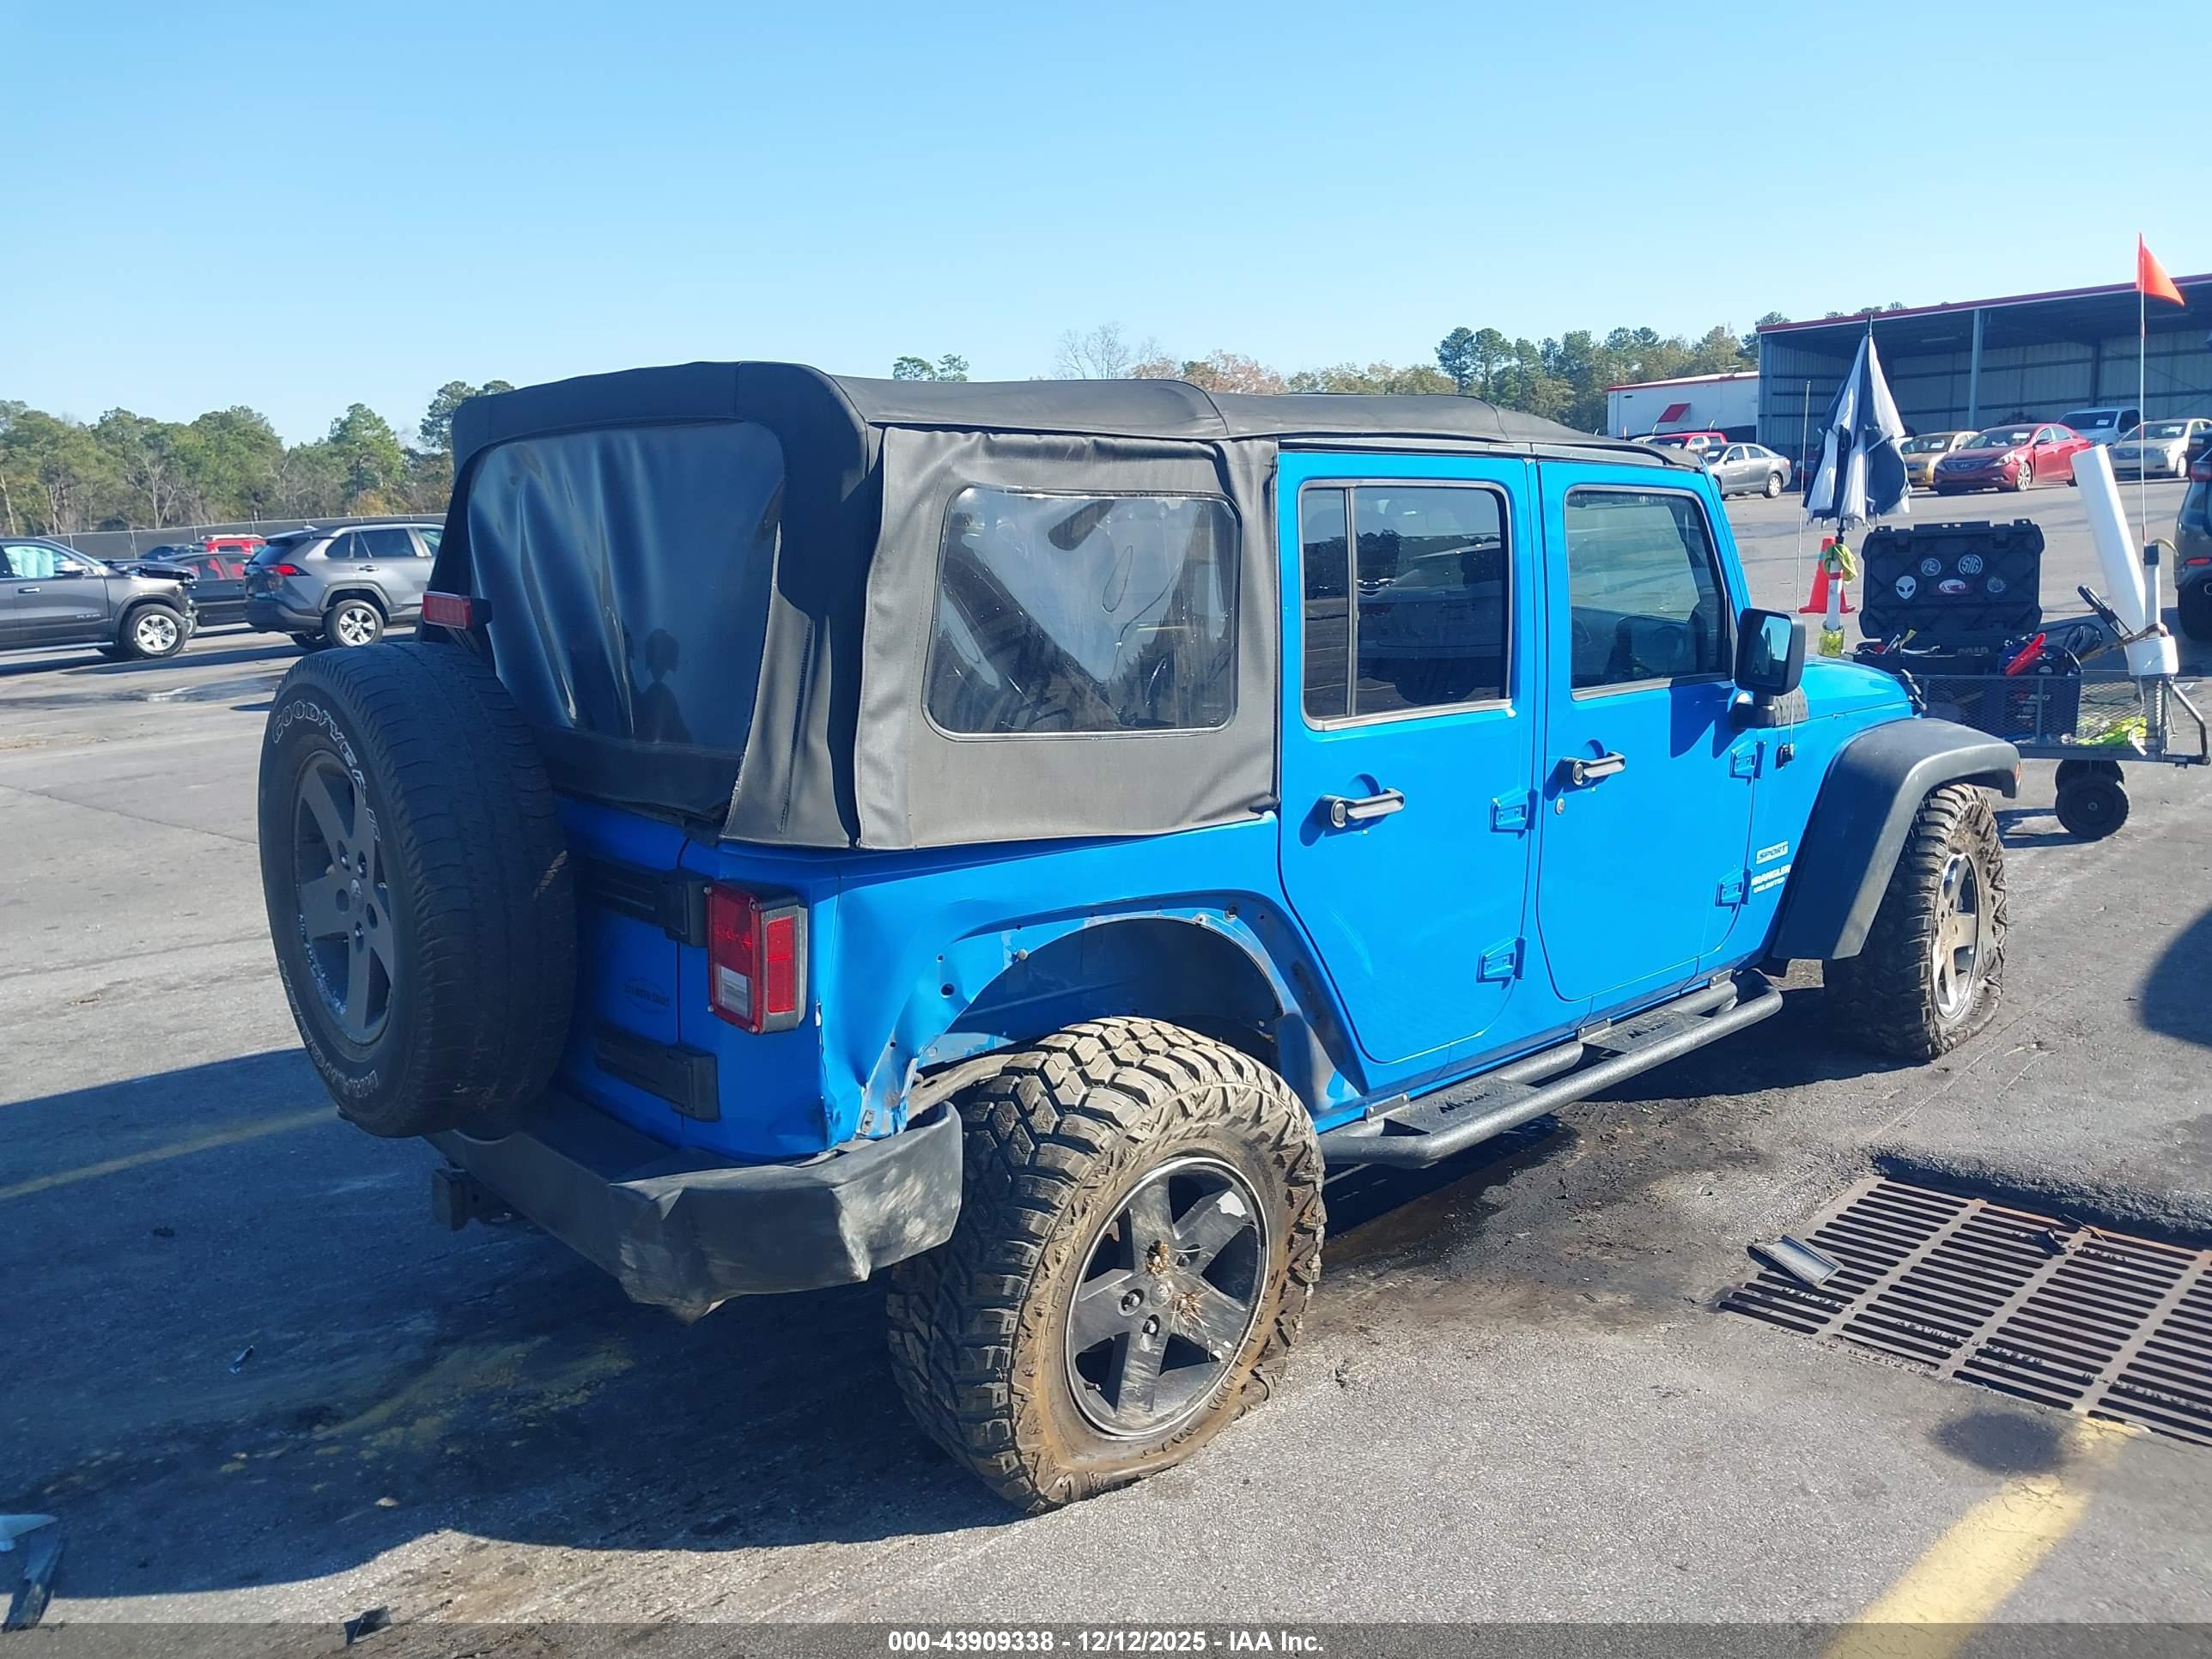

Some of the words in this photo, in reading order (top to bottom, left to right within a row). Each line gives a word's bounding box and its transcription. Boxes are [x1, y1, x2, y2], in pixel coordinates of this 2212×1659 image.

[1961, 557, 1979, 574] SIG
[271, 700, 381, 842] GOODYEAR
[1759, 844, 1786, 859] SPORT
